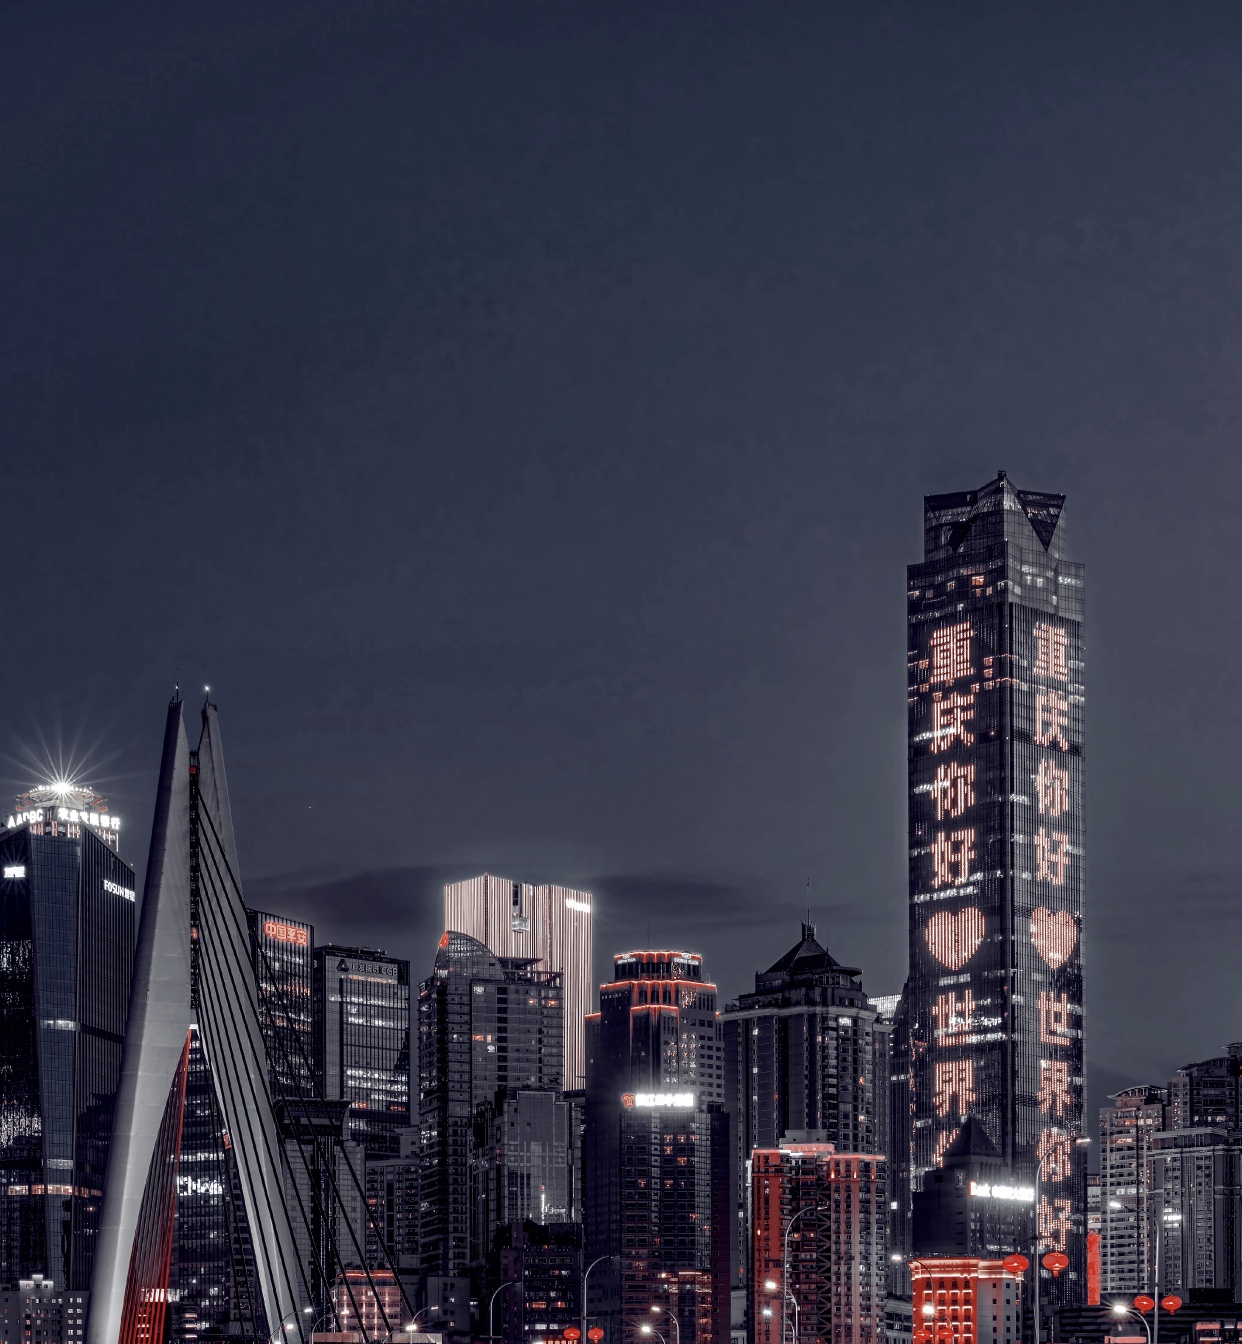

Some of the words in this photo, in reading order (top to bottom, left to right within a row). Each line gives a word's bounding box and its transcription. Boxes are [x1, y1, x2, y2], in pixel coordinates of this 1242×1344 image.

[929, 620, 975, 889] 重庆你好
[1034, 621, 1071, 887] 重庆你好
[103, 879, 124, 898] FOSUN
[265, 921, 308, 946] 中国平安
[381, 967, 398, 976] CGB
